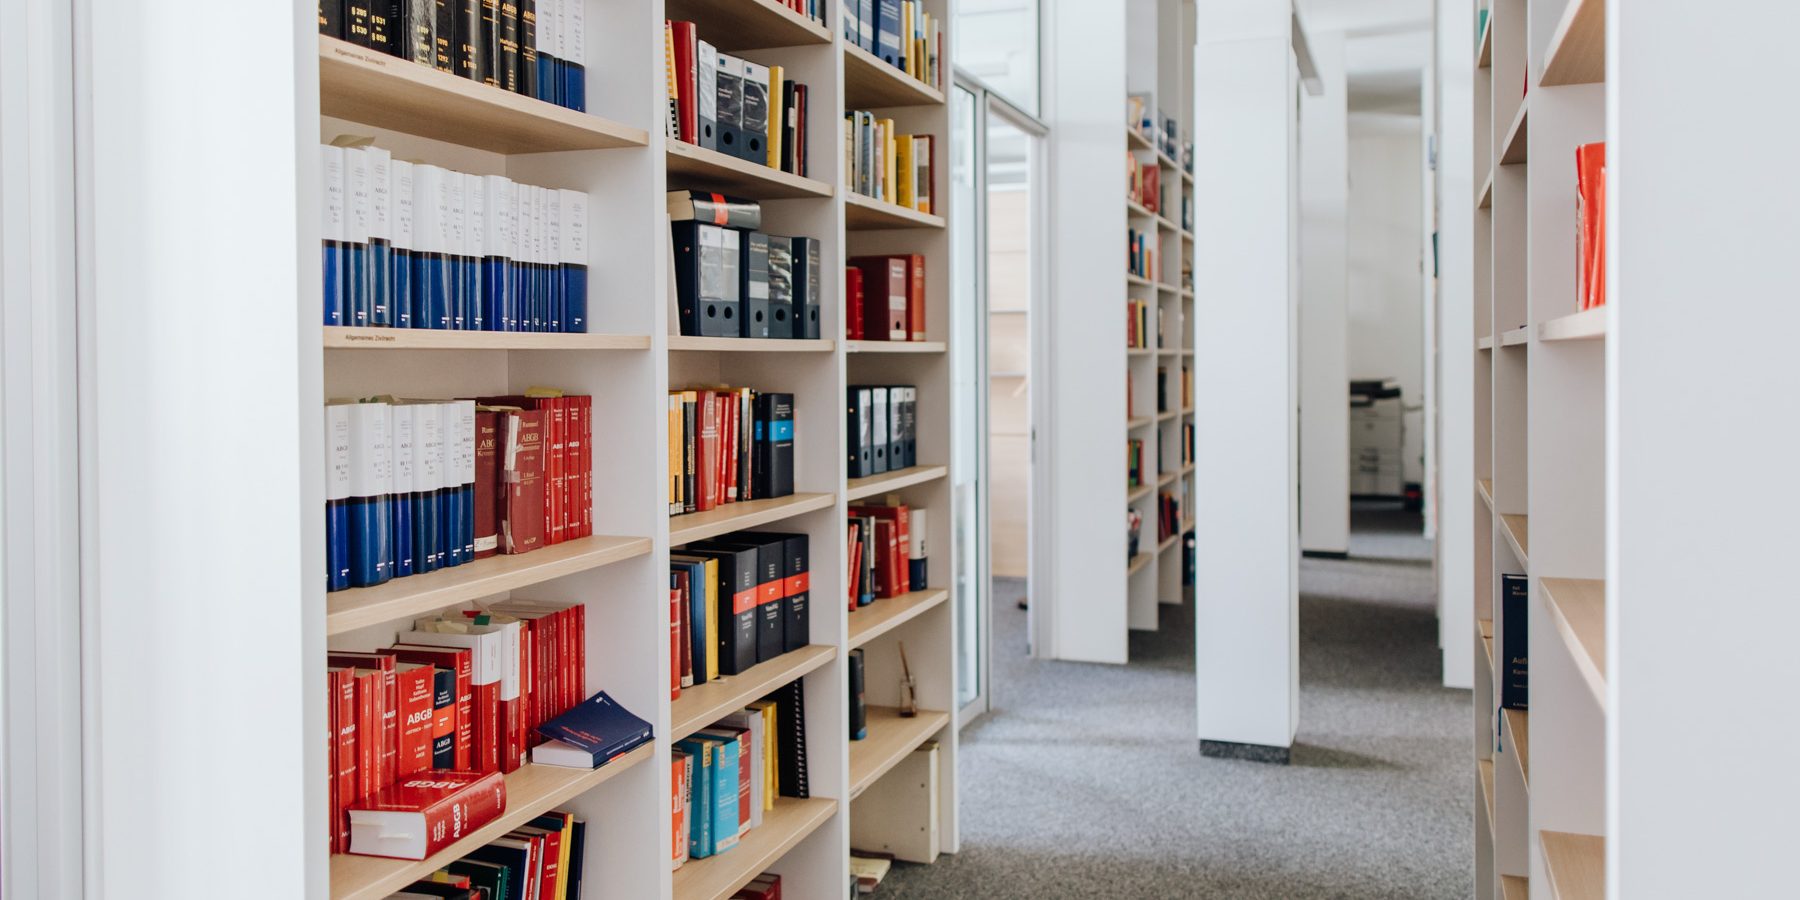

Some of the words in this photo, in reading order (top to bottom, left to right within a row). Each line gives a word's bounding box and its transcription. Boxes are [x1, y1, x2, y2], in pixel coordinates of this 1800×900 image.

[521, 432, 539, 443] ABGB
[407, 708, 433, 725] ABGB
[436, 738, 451, 749] ABGB
[404, 780, 469, 790] ABGB
